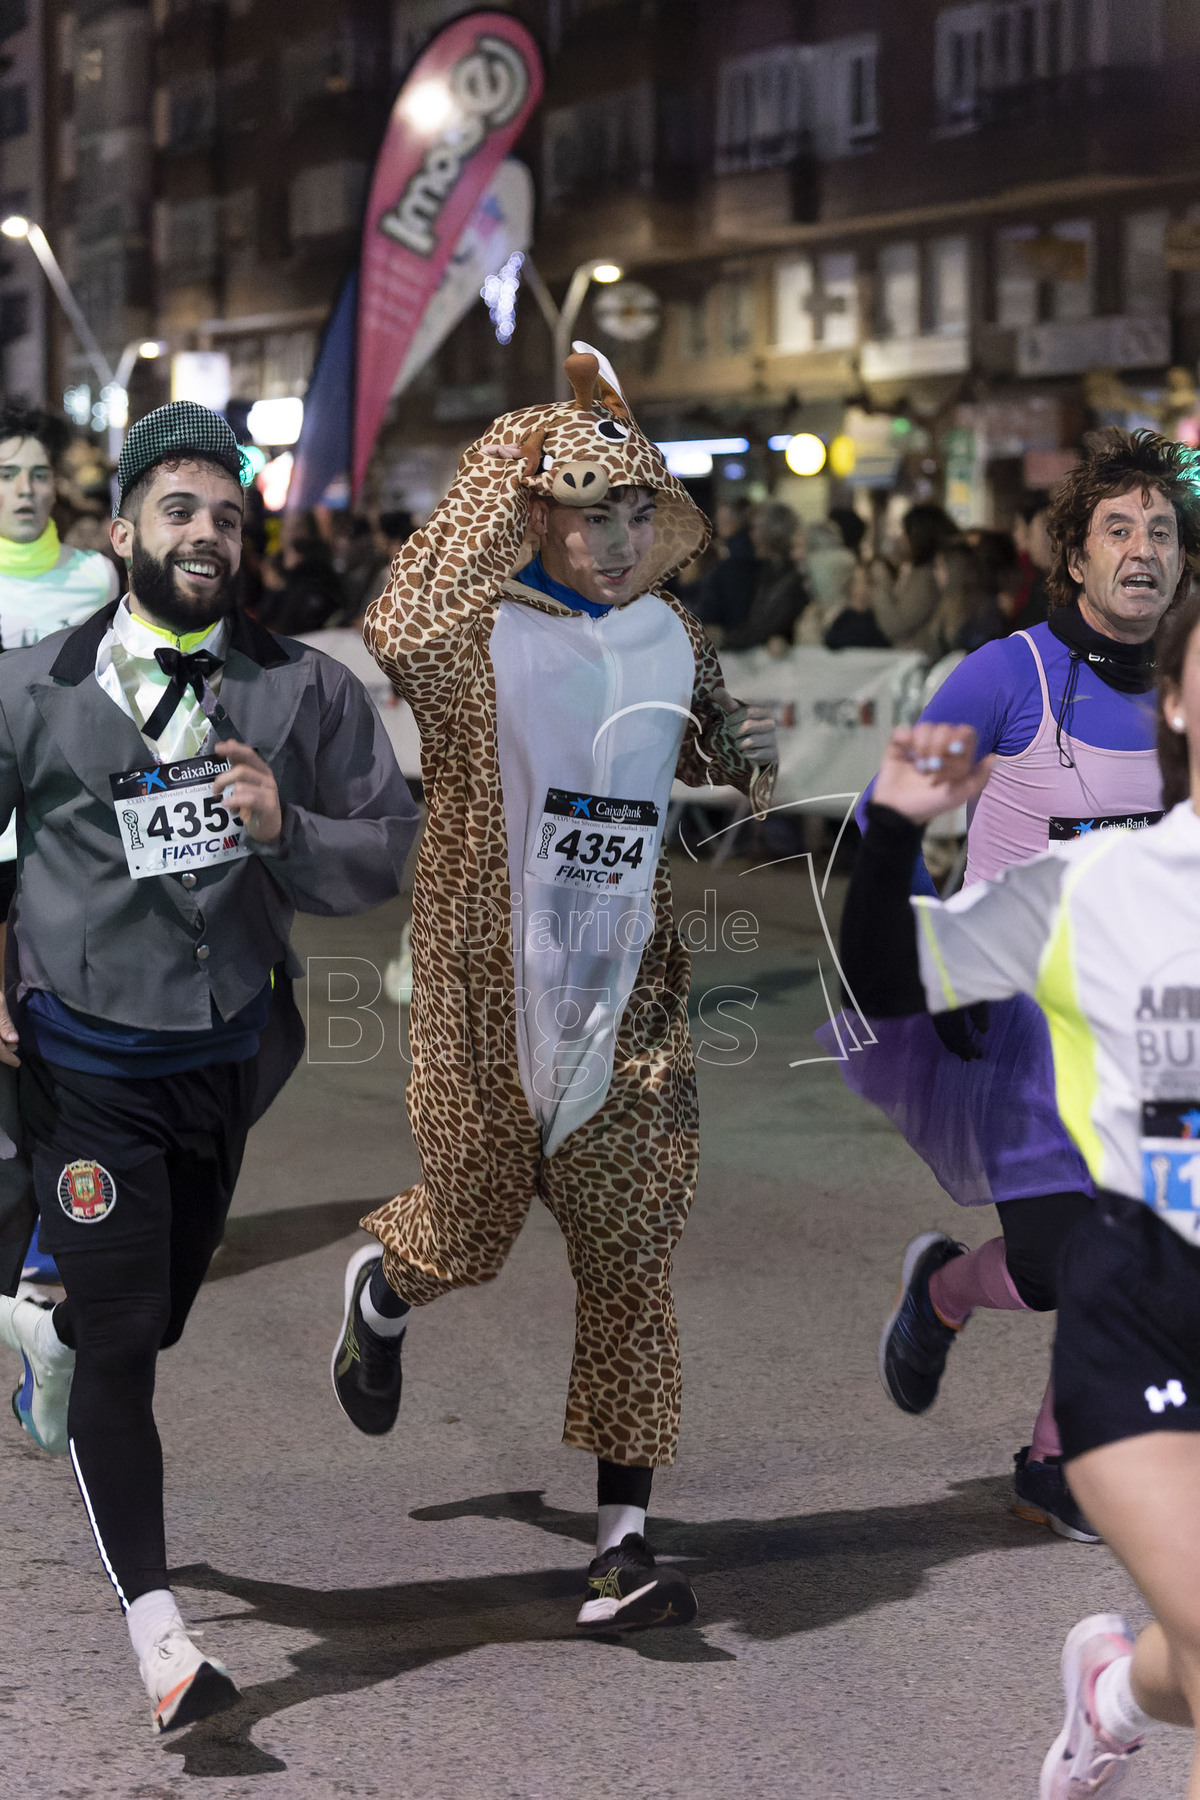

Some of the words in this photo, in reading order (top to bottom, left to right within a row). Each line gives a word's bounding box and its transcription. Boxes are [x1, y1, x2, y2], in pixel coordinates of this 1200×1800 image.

[147, 793, 244, 841] 435
[596, 801, 641, 819] CaixaBank
[555, 829, 644, 869] 4354
